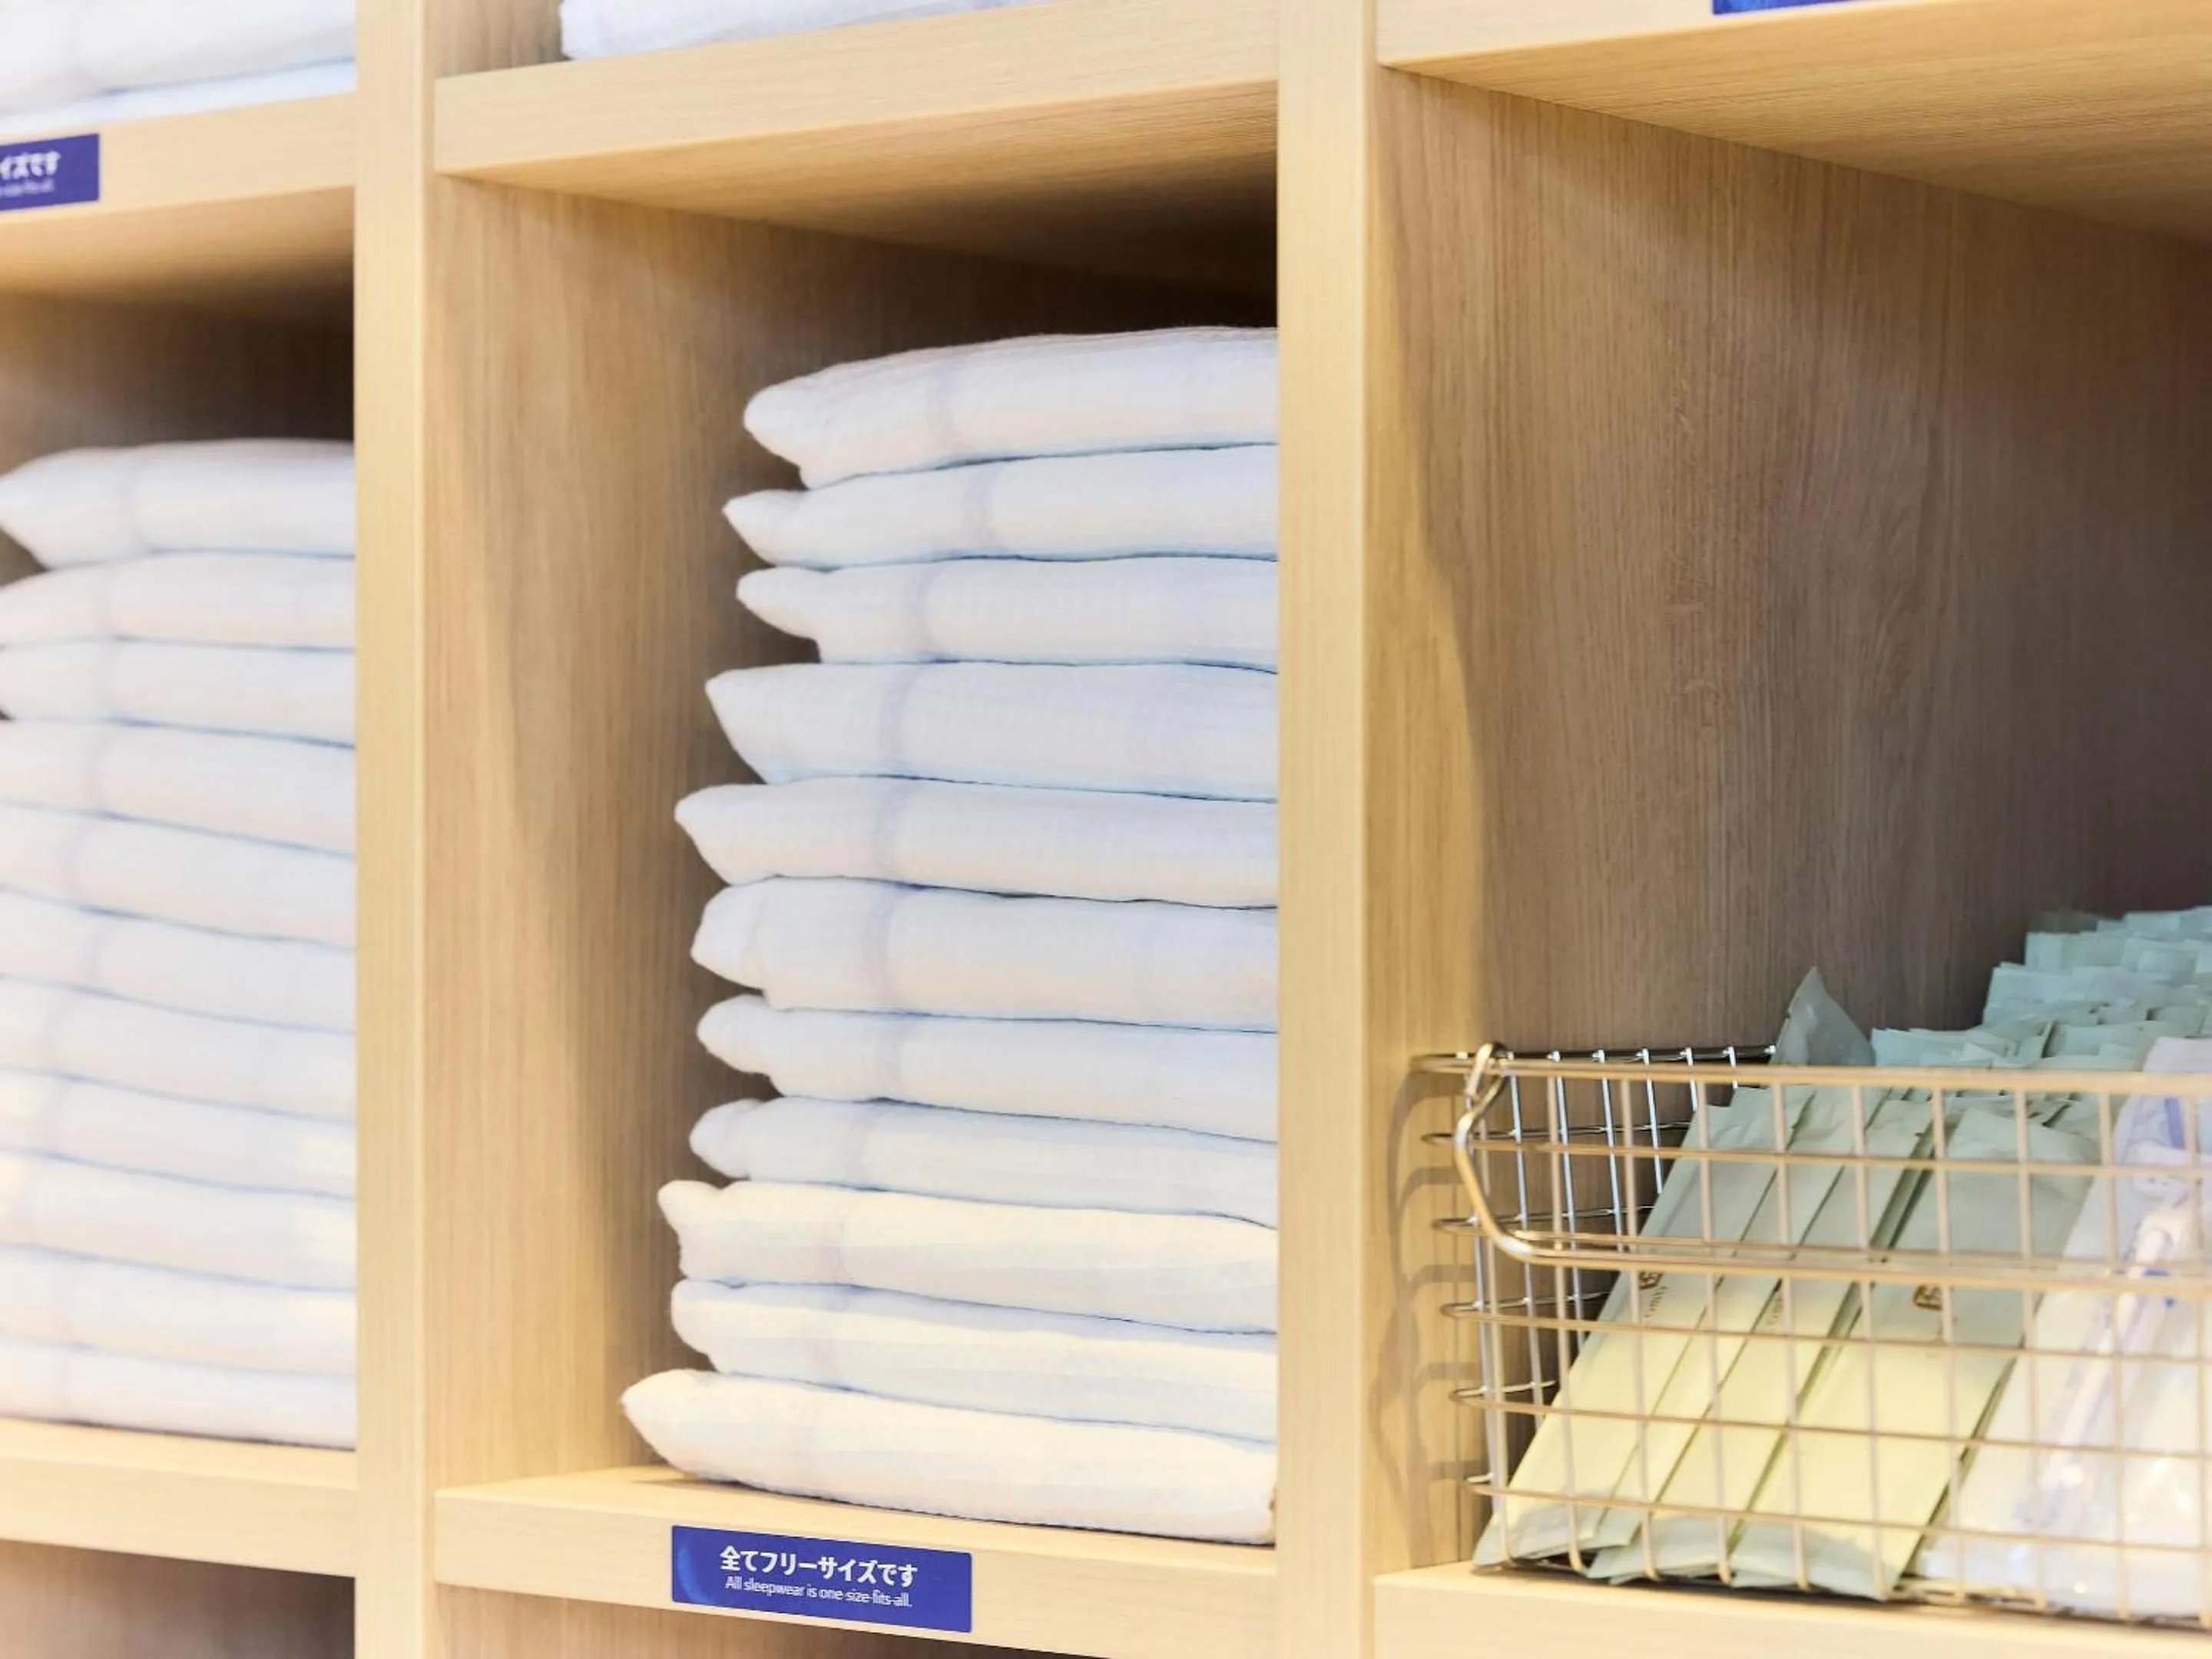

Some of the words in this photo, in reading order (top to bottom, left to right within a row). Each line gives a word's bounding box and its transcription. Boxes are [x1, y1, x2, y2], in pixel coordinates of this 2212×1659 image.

[720, 1545, 918, 1588] 全てフリーサイズです
[725, 1576, 742, 1590] All
[743, 1577, 806, 1597] sleepwear
[806, 1583, 818, 1598] is
[818, 1589, 844, 1601] one
